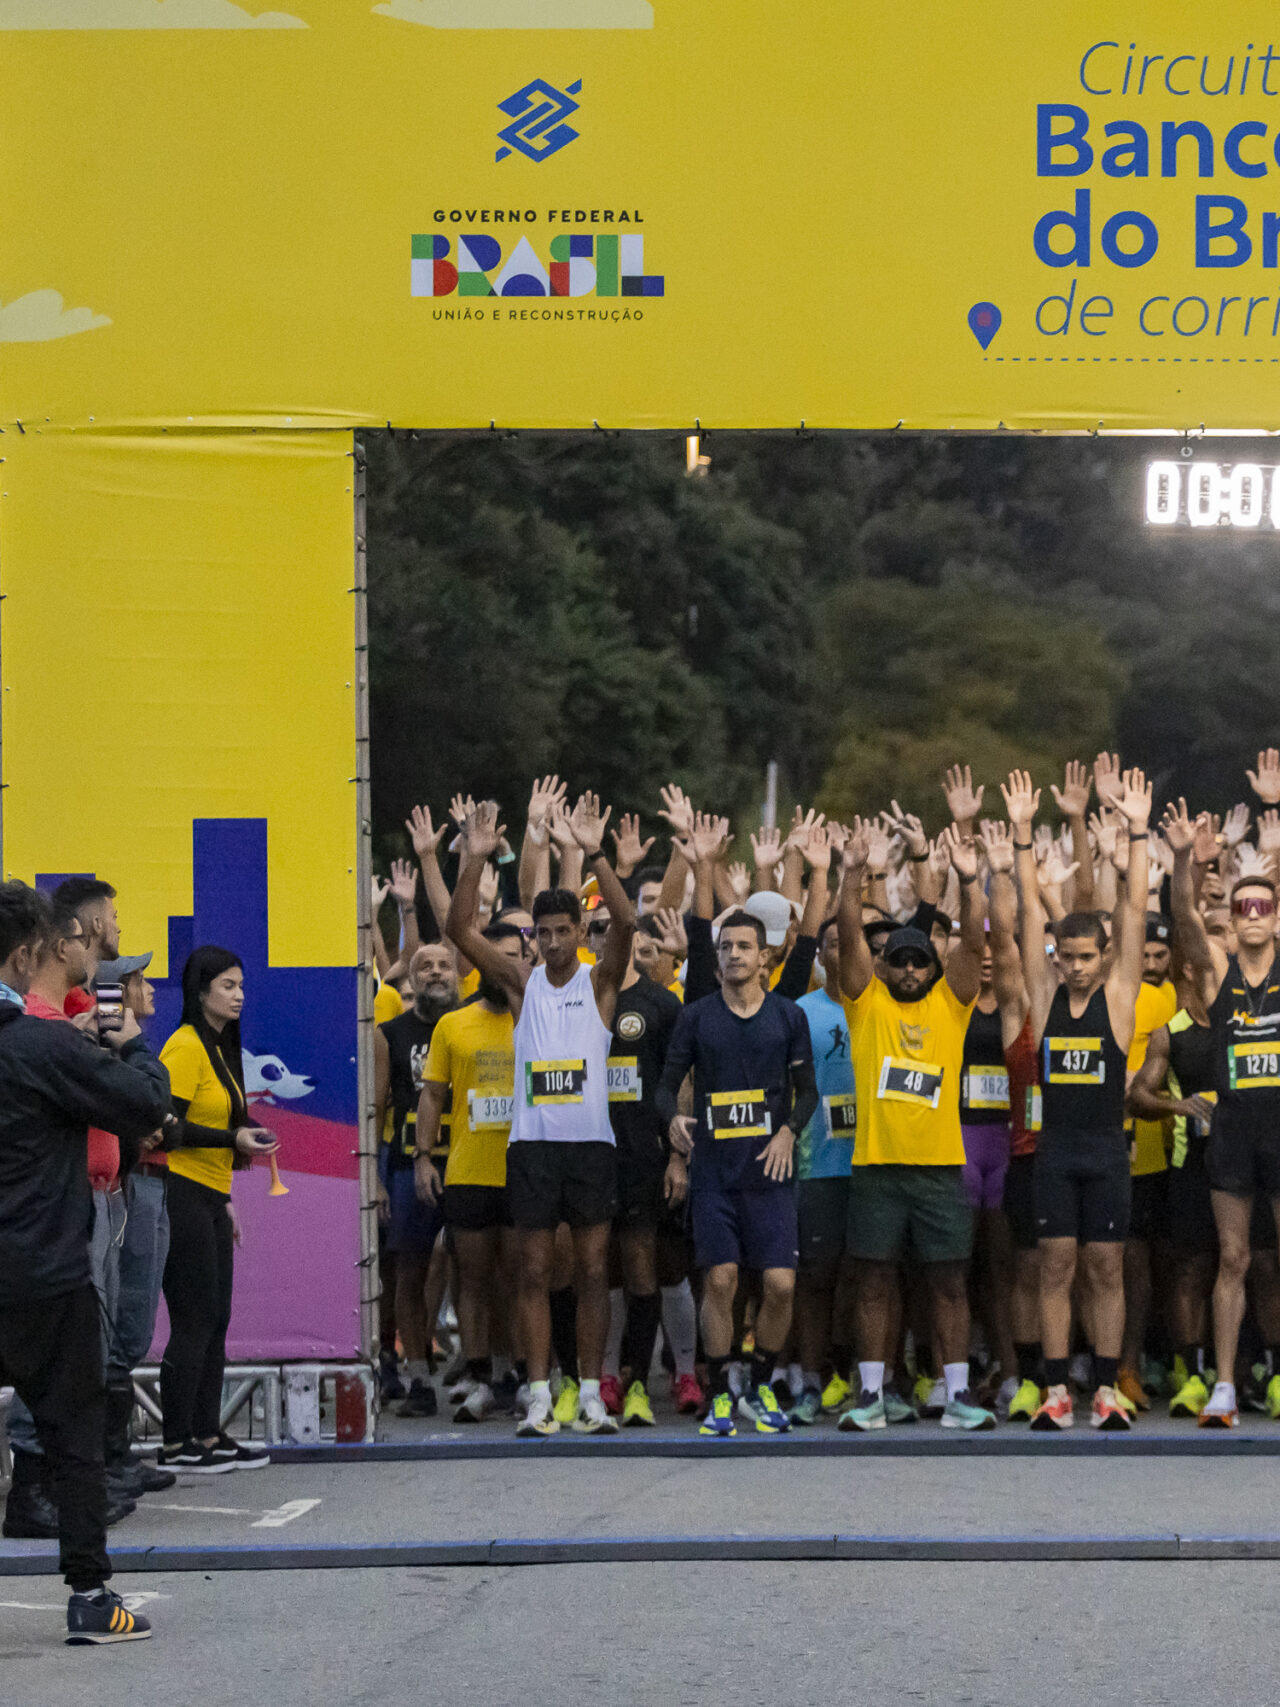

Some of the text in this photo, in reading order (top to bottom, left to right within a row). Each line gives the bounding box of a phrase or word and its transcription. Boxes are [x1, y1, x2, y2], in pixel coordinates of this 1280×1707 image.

[433, 209, 645, 223] GOVERNO FEDERAL
[1033, 188, 1159, 268] do
[411, 234, 665, 297] BRASIL
[432, 307, 644, 323] UNIÃO E RECONSTRUÇÃO
[1035, 279, 1115, 337] de
[1062, 1050, 1090, 1071] 437
[1246, 1054, 1278, 1075] 1279
[545, 1070, 574, 1092] 1104
[607, 1068, 630, 1087] 026
[904, 1071, 924, 1092] 48
[728, 1102, 754, 1124] 471
